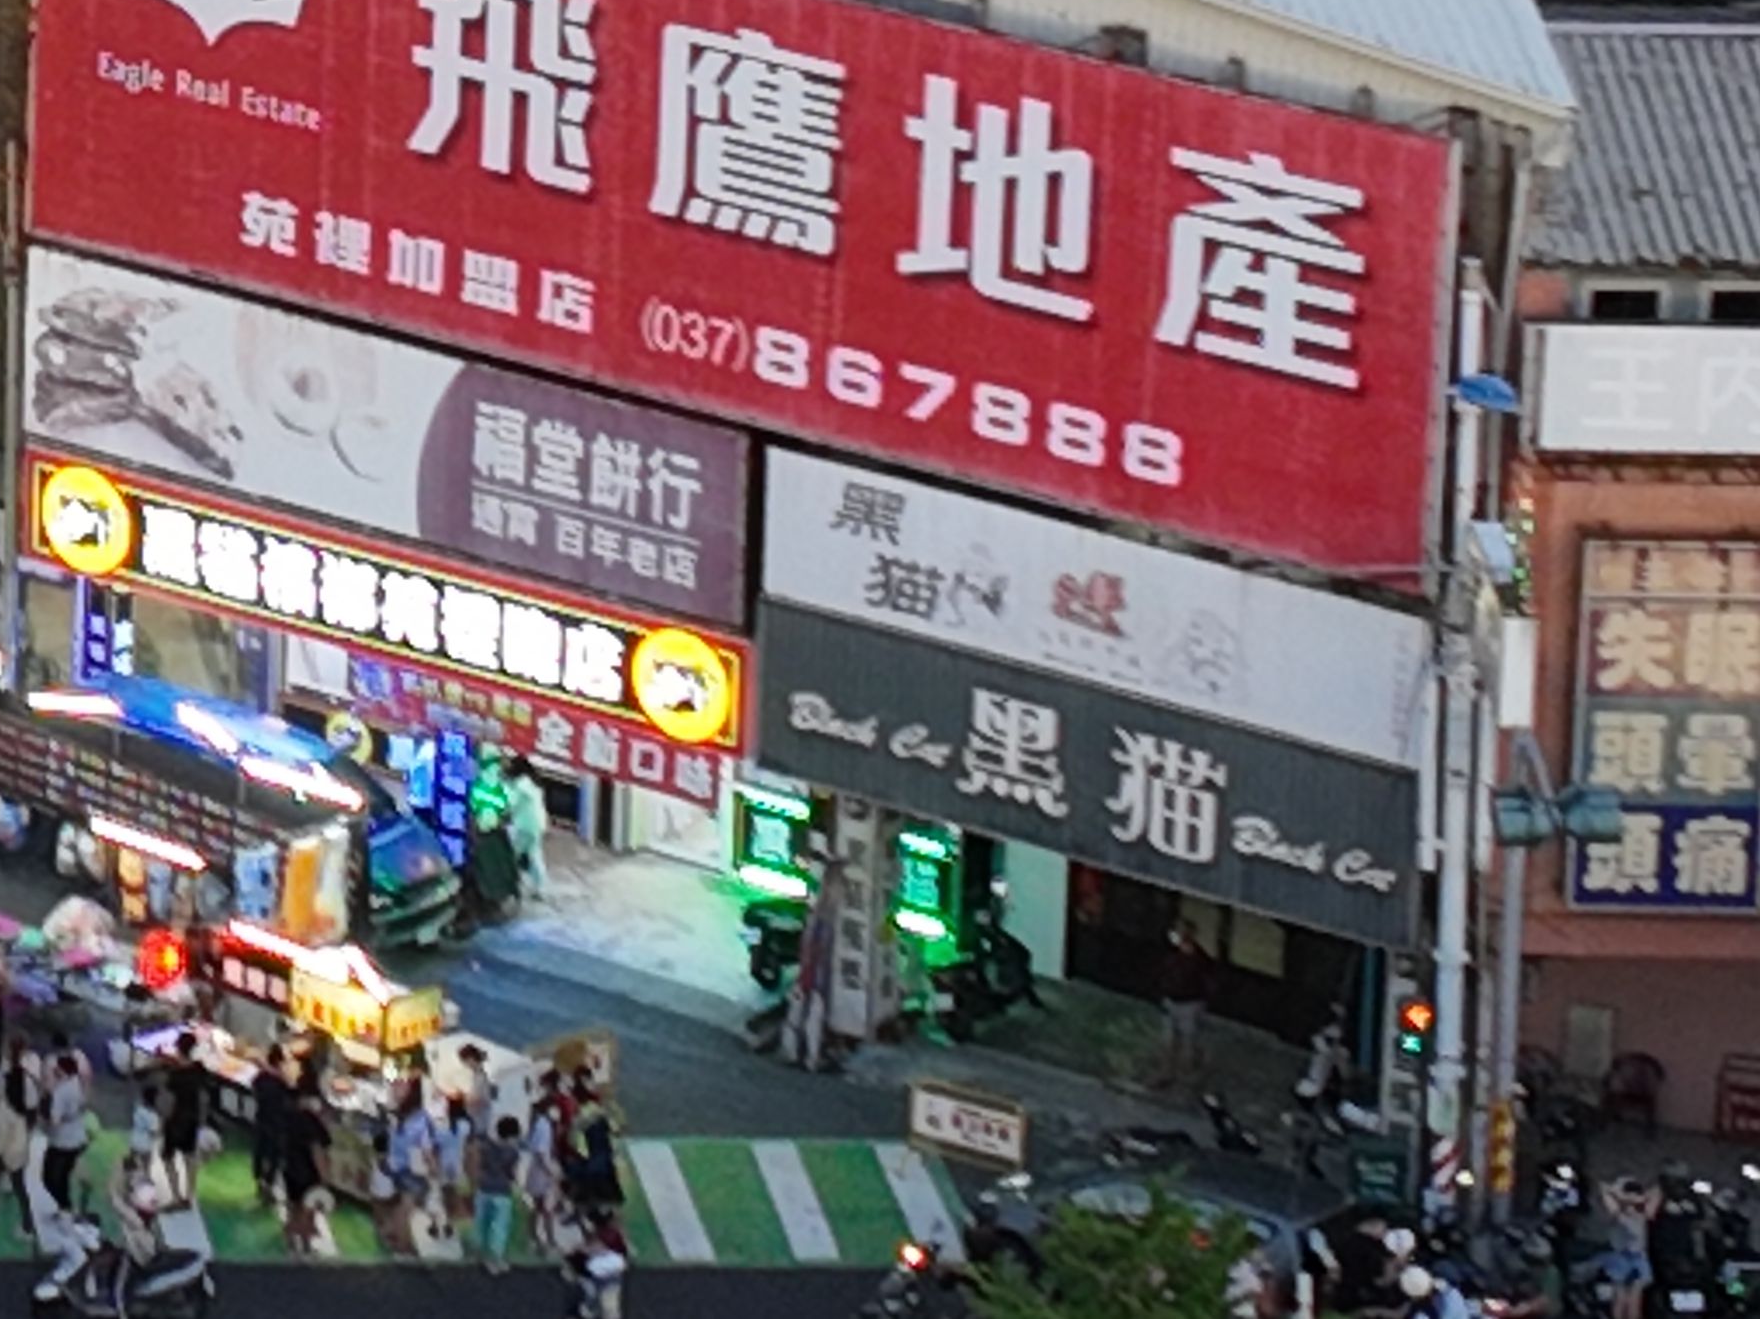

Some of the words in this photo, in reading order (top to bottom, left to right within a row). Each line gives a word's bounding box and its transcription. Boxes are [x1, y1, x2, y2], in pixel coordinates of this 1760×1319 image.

[97, 50, 165, 95] Eagle
[175, 69, 230, 108] Real
[240, 87, 323, 132] Estate
[239, 190, 597, 334] 苑裡加盟店
[1596, 607, 1760, 695] 失眠
[1590, 710, 1756, 798] 頭暈
[1584, 809, 1751, 897] 頭痛
